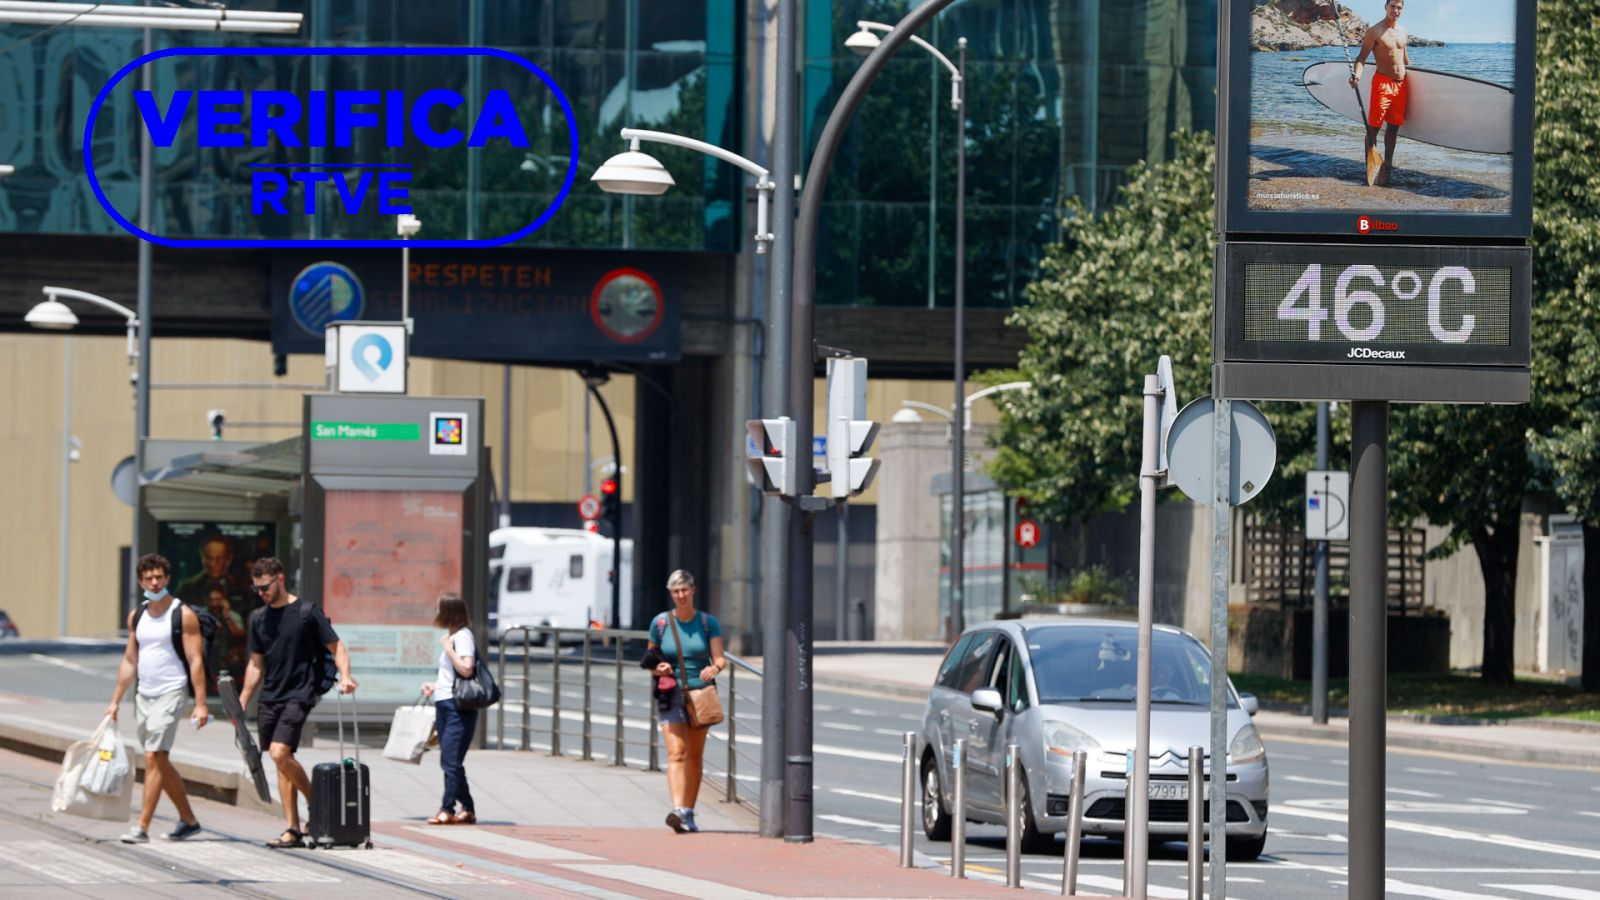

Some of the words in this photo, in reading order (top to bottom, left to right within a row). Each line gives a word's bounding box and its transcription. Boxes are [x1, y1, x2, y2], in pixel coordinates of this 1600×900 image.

[1359, 217, 1398, 231] Bilbao
[407, 263, 552, 288] RESPETEN
[1277, 263, 1476, 344] 46°C
[1347, 347, 1406, 359] JCDecaux
[315, 424, 336, 437] San
[338, 425, 378, 438] Mamés
[1148, 785, 1177, 798] 2799
